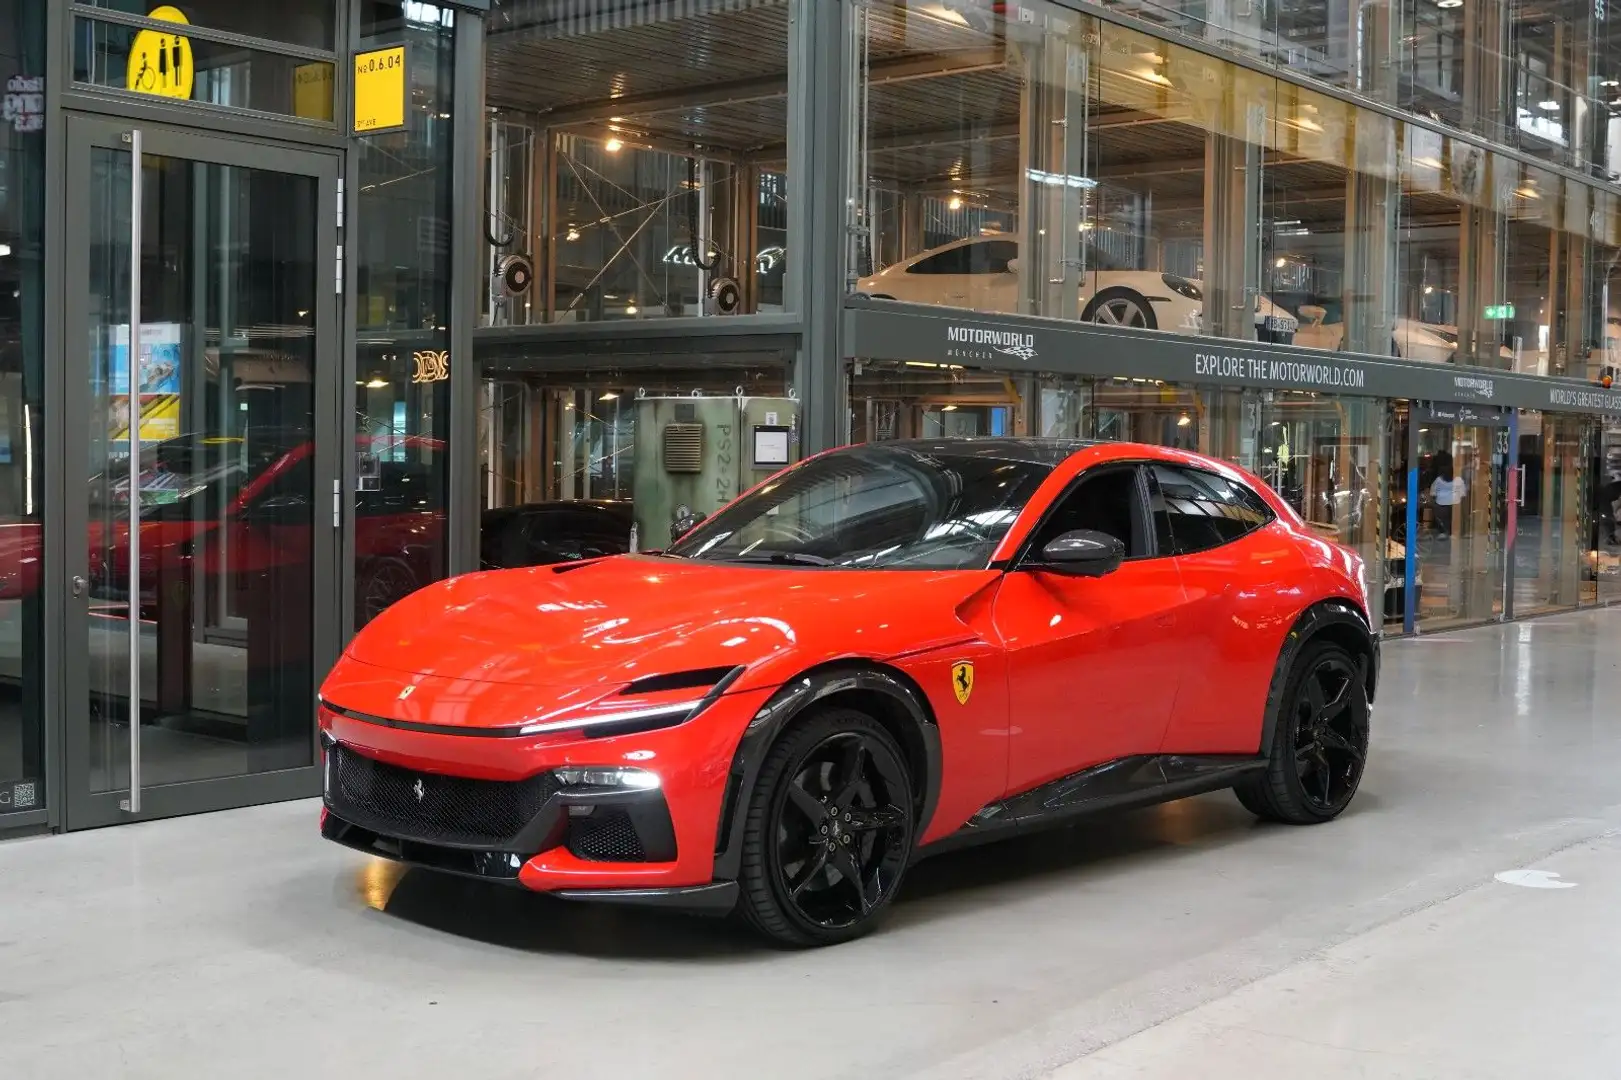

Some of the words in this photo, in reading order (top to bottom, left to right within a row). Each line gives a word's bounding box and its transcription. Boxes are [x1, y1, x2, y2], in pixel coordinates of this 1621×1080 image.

[369, 54, 401, 72] 0.6.04
[947, 326, 1034, 348] MOTORWORLD
[1195, 353, 1245, 378] EXPLORE
[1247, 358, 1267, 379] THE
[1269, 360, 1364, 388] MOTORWORLD.COM
[1454, 376, 1494, 390] MOTORWORLD
[1549, 388, 1577, 406] WORLD'S
[1577, 391, 1604, 409] GREATEST
